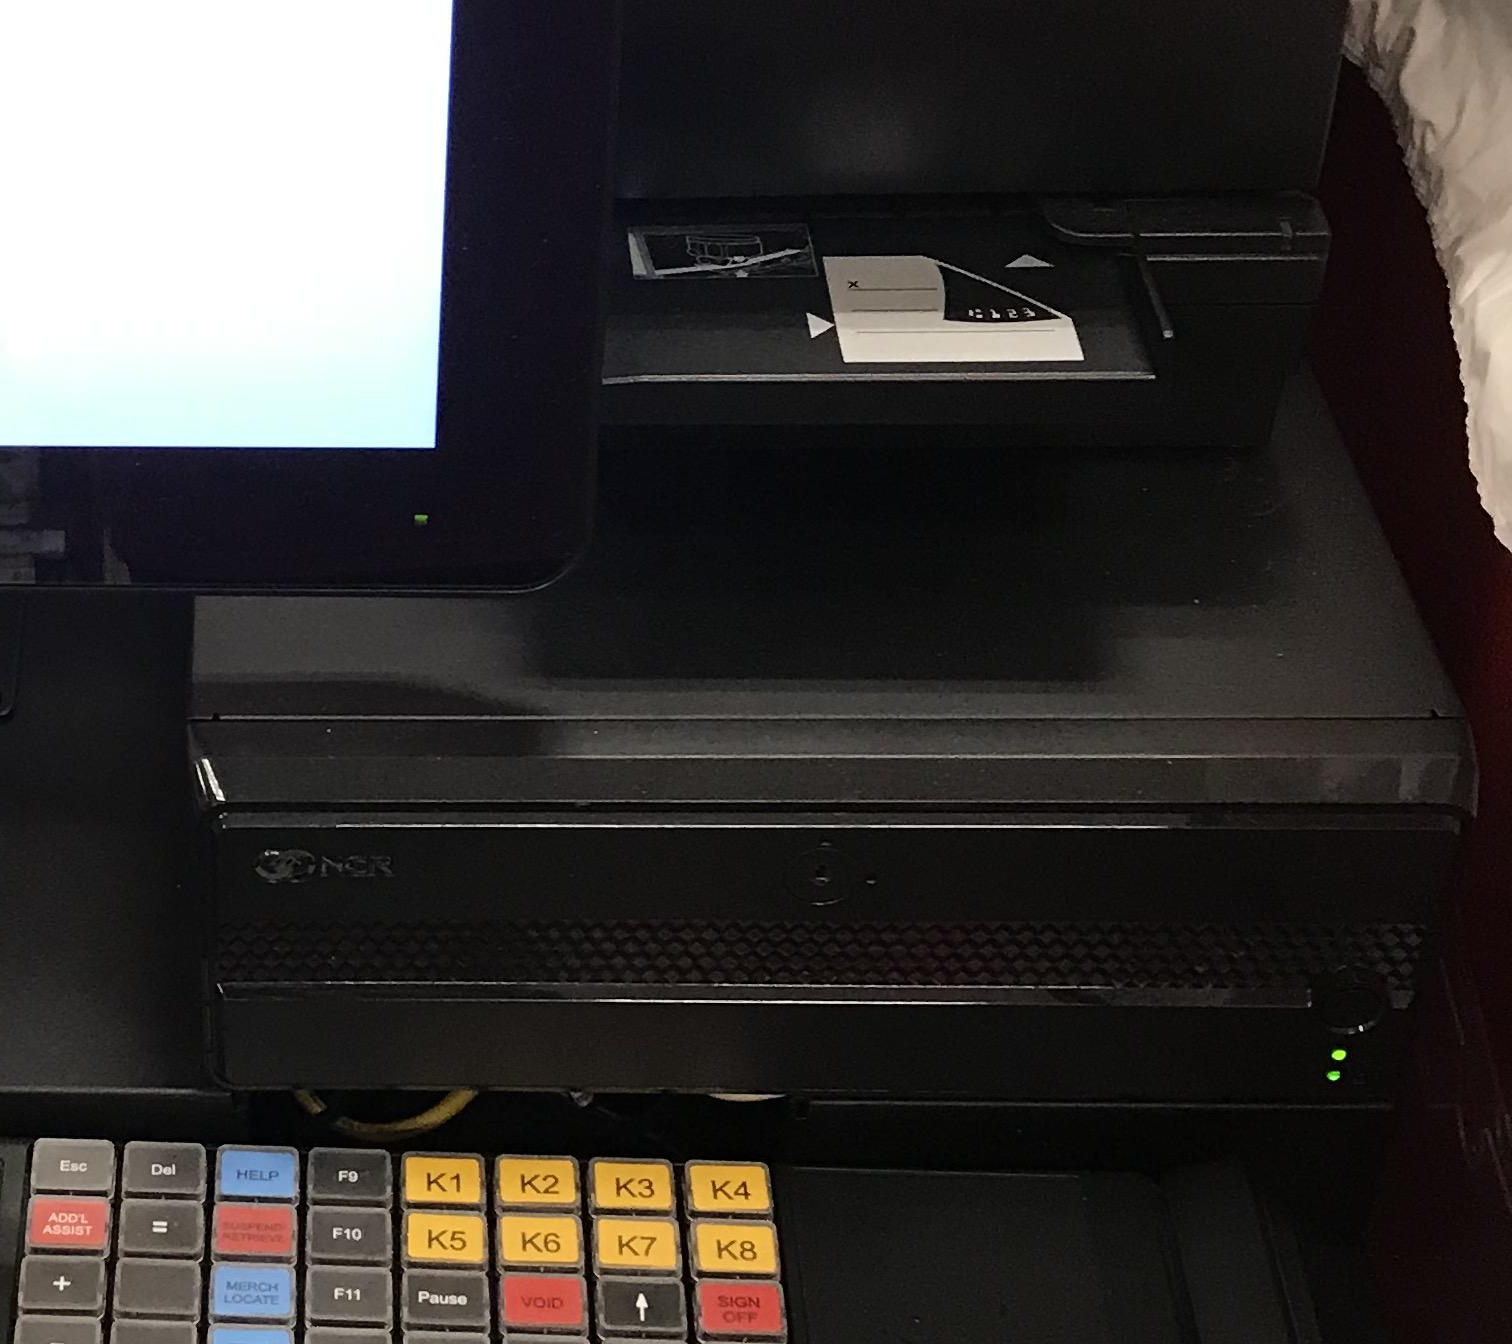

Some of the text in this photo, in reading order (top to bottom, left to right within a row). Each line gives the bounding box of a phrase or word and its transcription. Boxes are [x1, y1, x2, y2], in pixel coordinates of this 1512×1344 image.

[59, 1159, 88, 1173] Esc
[150, 1163, 176, 1176] Del
[235, 1167, 281, 1182] HELP
[338, 1170, 359, 1183] F9
[425, 1171, 464, 1194] K1
[519, 1173, 561, 1196] K2
[614, 1176, 655, 1200] K3
[711, 1180, 751, 1202] K4
[42, 1224, 93, 1236] ASSIST
[332, 1227, 362, 1241] F10
[426, 1229, 467, 1252] K5
[520, 1232, 562, 1254] K6
[616, 1234, 656, 1257] K7
[715, 1239, 758, 1261] K8
[225, 1281, 279, 1293] MERCH
[333, 1287, 361, 1301] F11
[223, 1294, 280, 1306] LOCATE
[418, 1290, 468, 1306] Pause
[520, 1295, 565, 1311] VOID
[717, 1295, 761, 1309] SIGN
[722, 1310, 759, 1324] OFF
